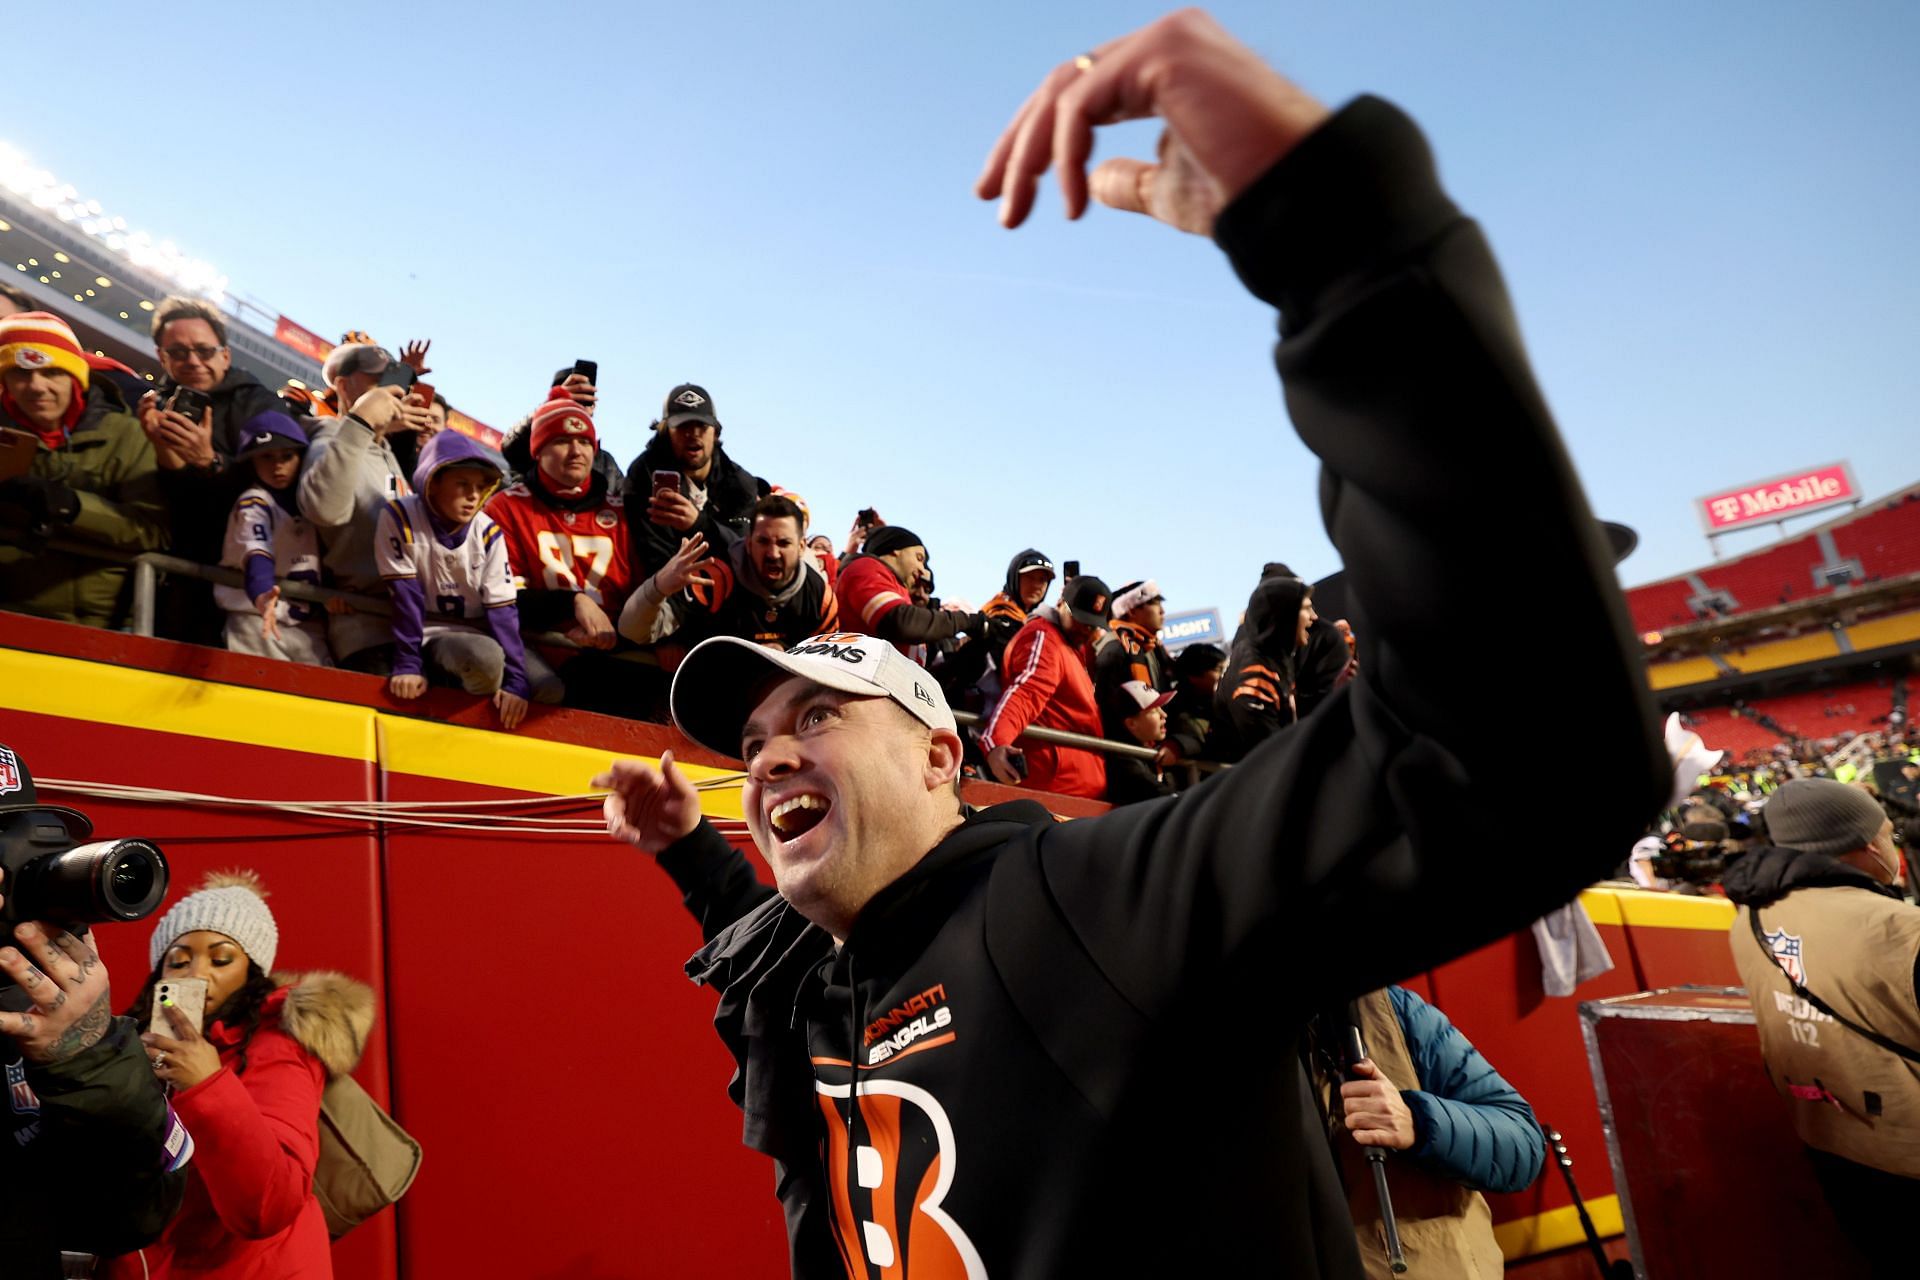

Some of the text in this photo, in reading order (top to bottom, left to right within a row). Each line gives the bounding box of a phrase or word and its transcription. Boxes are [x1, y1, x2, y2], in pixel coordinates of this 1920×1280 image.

[1740, 476, 1841, 516] Mobile
[252, 523, 268, 541] 9
[537, 530, 613, 605] 87
[1164, 618, 1211, 639] LIGHT
[785, 643, 866, 664] IONS
[868, 1006, 952, 1066] BENGALS
